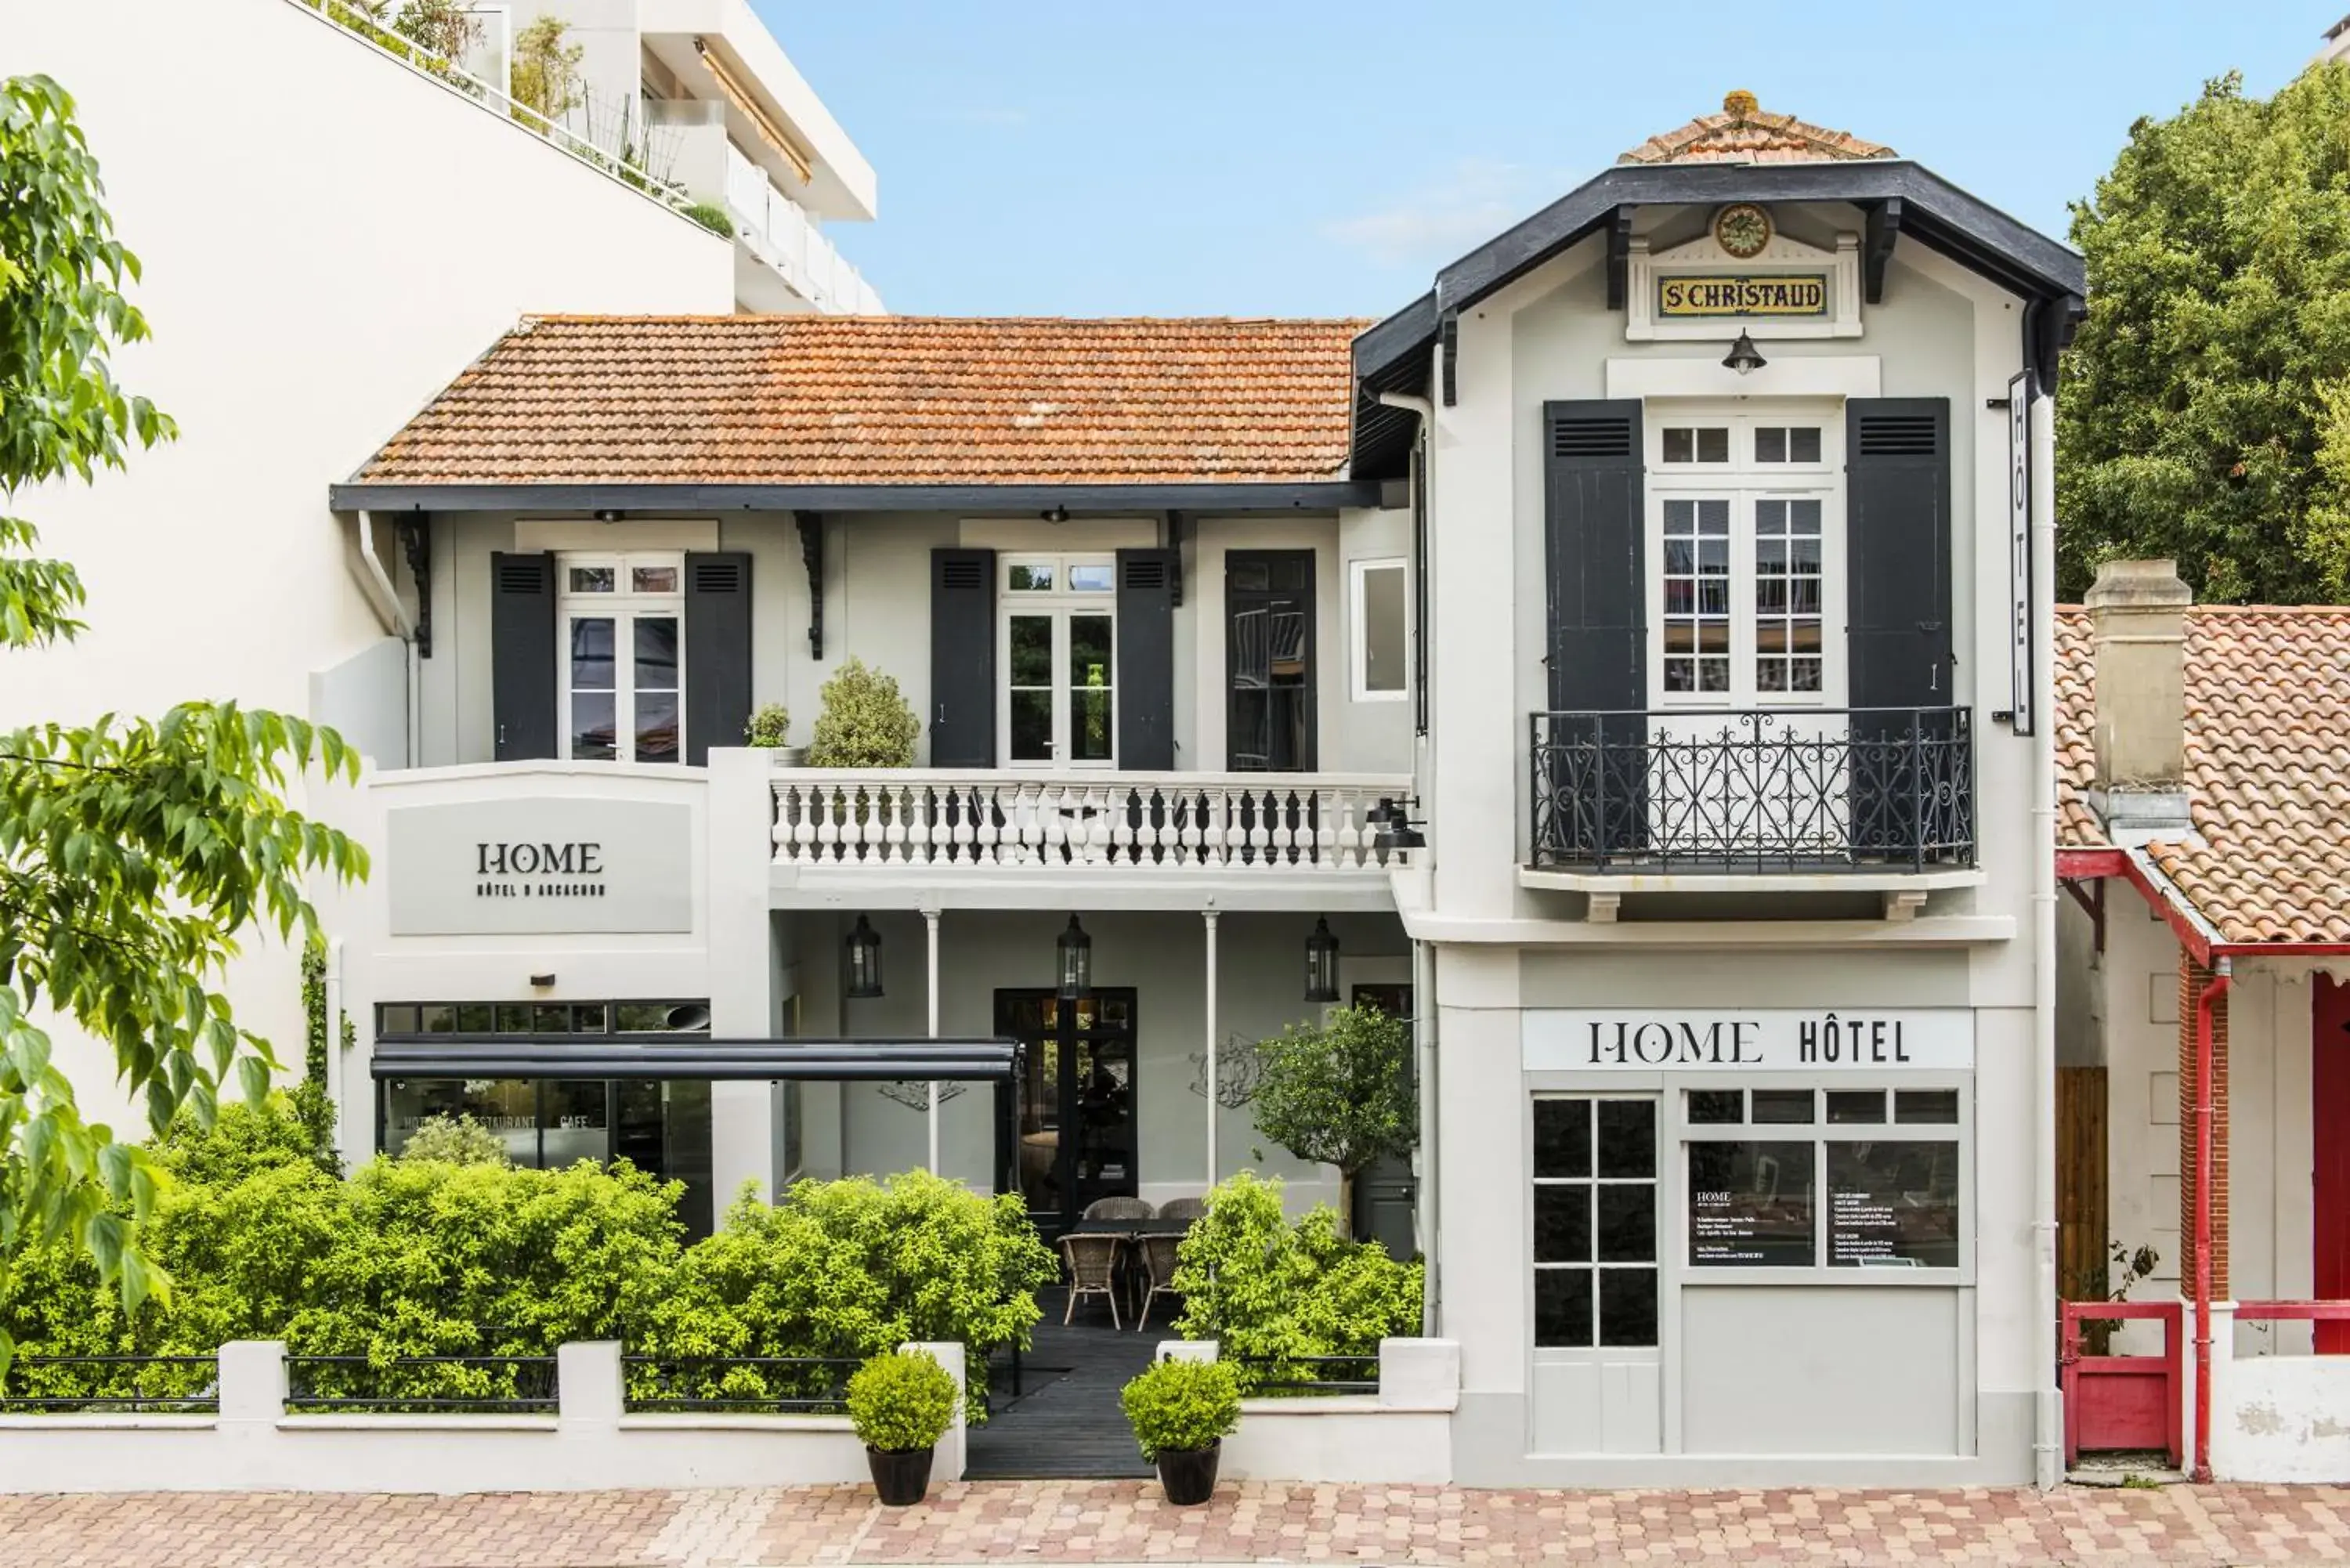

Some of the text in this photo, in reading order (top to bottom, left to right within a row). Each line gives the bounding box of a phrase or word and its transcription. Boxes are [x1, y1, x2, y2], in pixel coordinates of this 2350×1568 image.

[1687, 284, 1820, 307] CHRISTAUD
[2014, 398, 2025, 713] HÔTEL
[477, 844, 603, 873] HOME
[477, 881, 516, 897] HÔTEL
[1587, 1012, 1910, 1064] HOME HÔTEL
[472, 1116, 536, 1129] STAURANT
[1697, 1191, 1731, 1201] HOME
